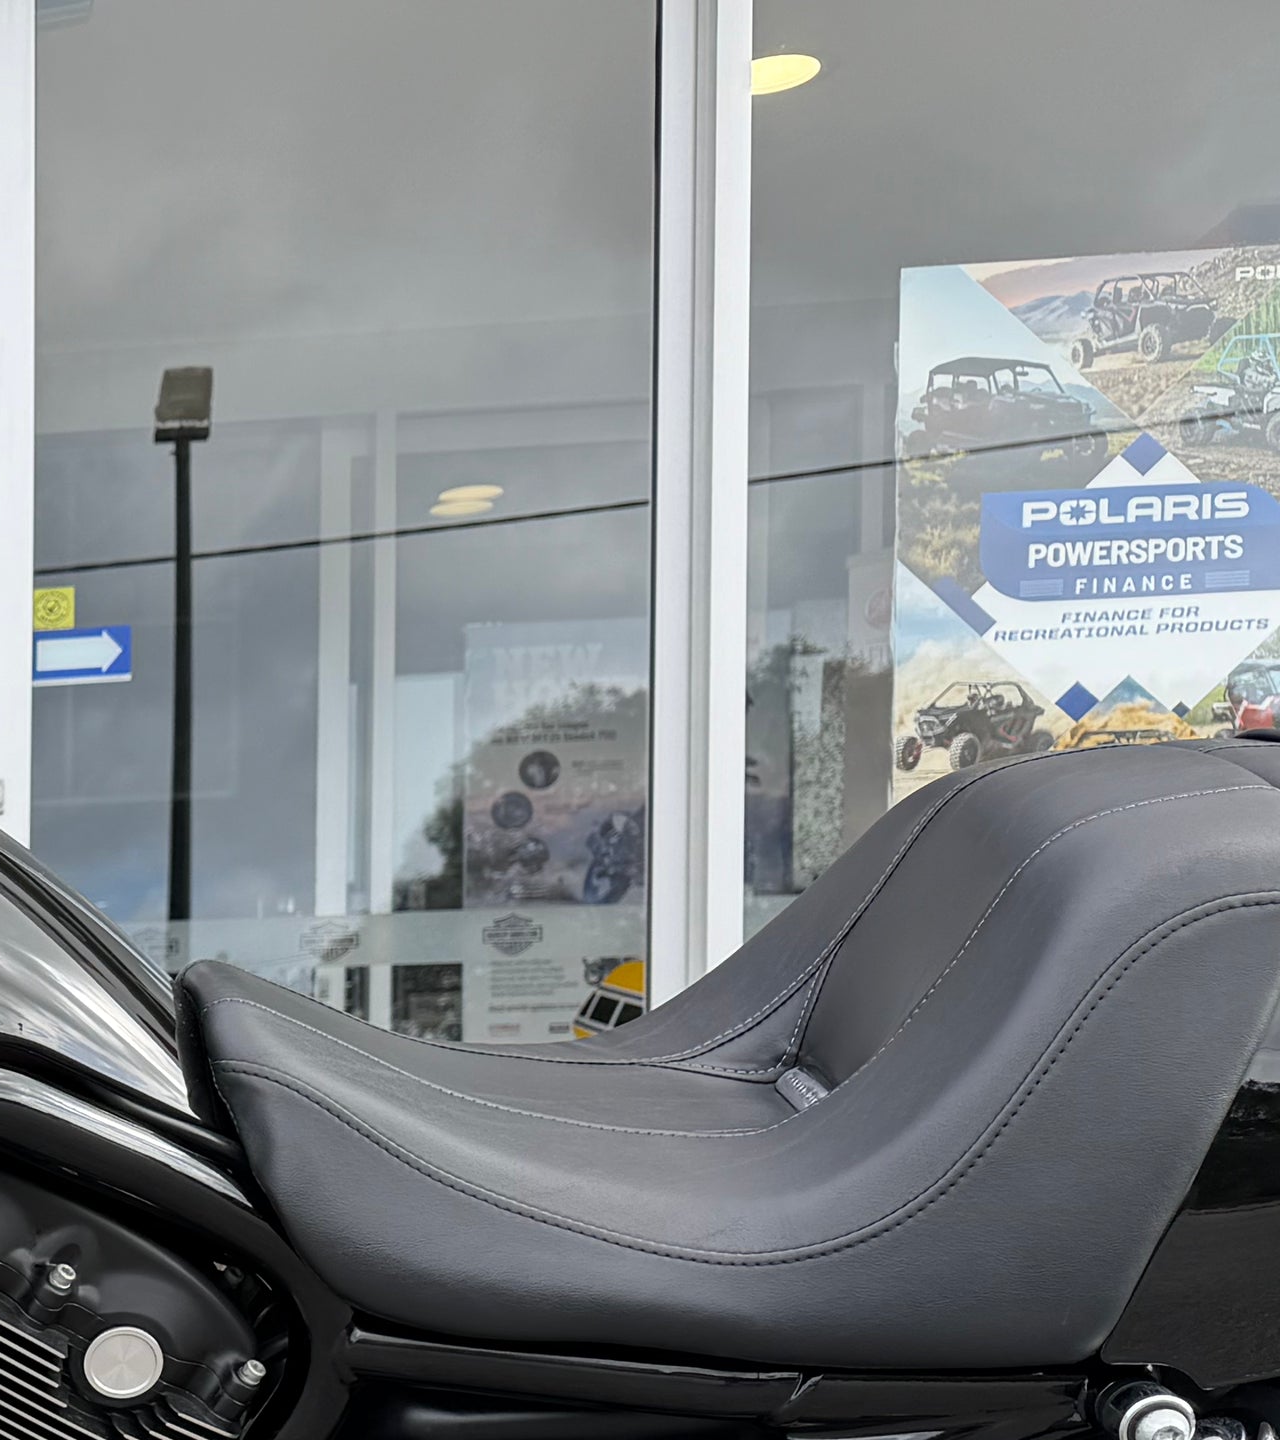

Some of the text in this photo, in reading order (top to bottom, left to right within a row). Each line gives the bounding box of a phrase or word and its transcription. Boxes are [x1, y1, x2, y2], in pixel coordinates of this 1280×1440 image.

[1235, 264, 1280, 282] PO
[1022, 491, 1250, 528] POLARIS
[1027, 534, 1244, 569] POWERSPORTS
[1075, 573, 1193, 595] FINANCE
[1061, 605, 1200, 624] FINANCE FOR
[993, 618, 1269, 642] RECREATIONAL PRODUCTS
